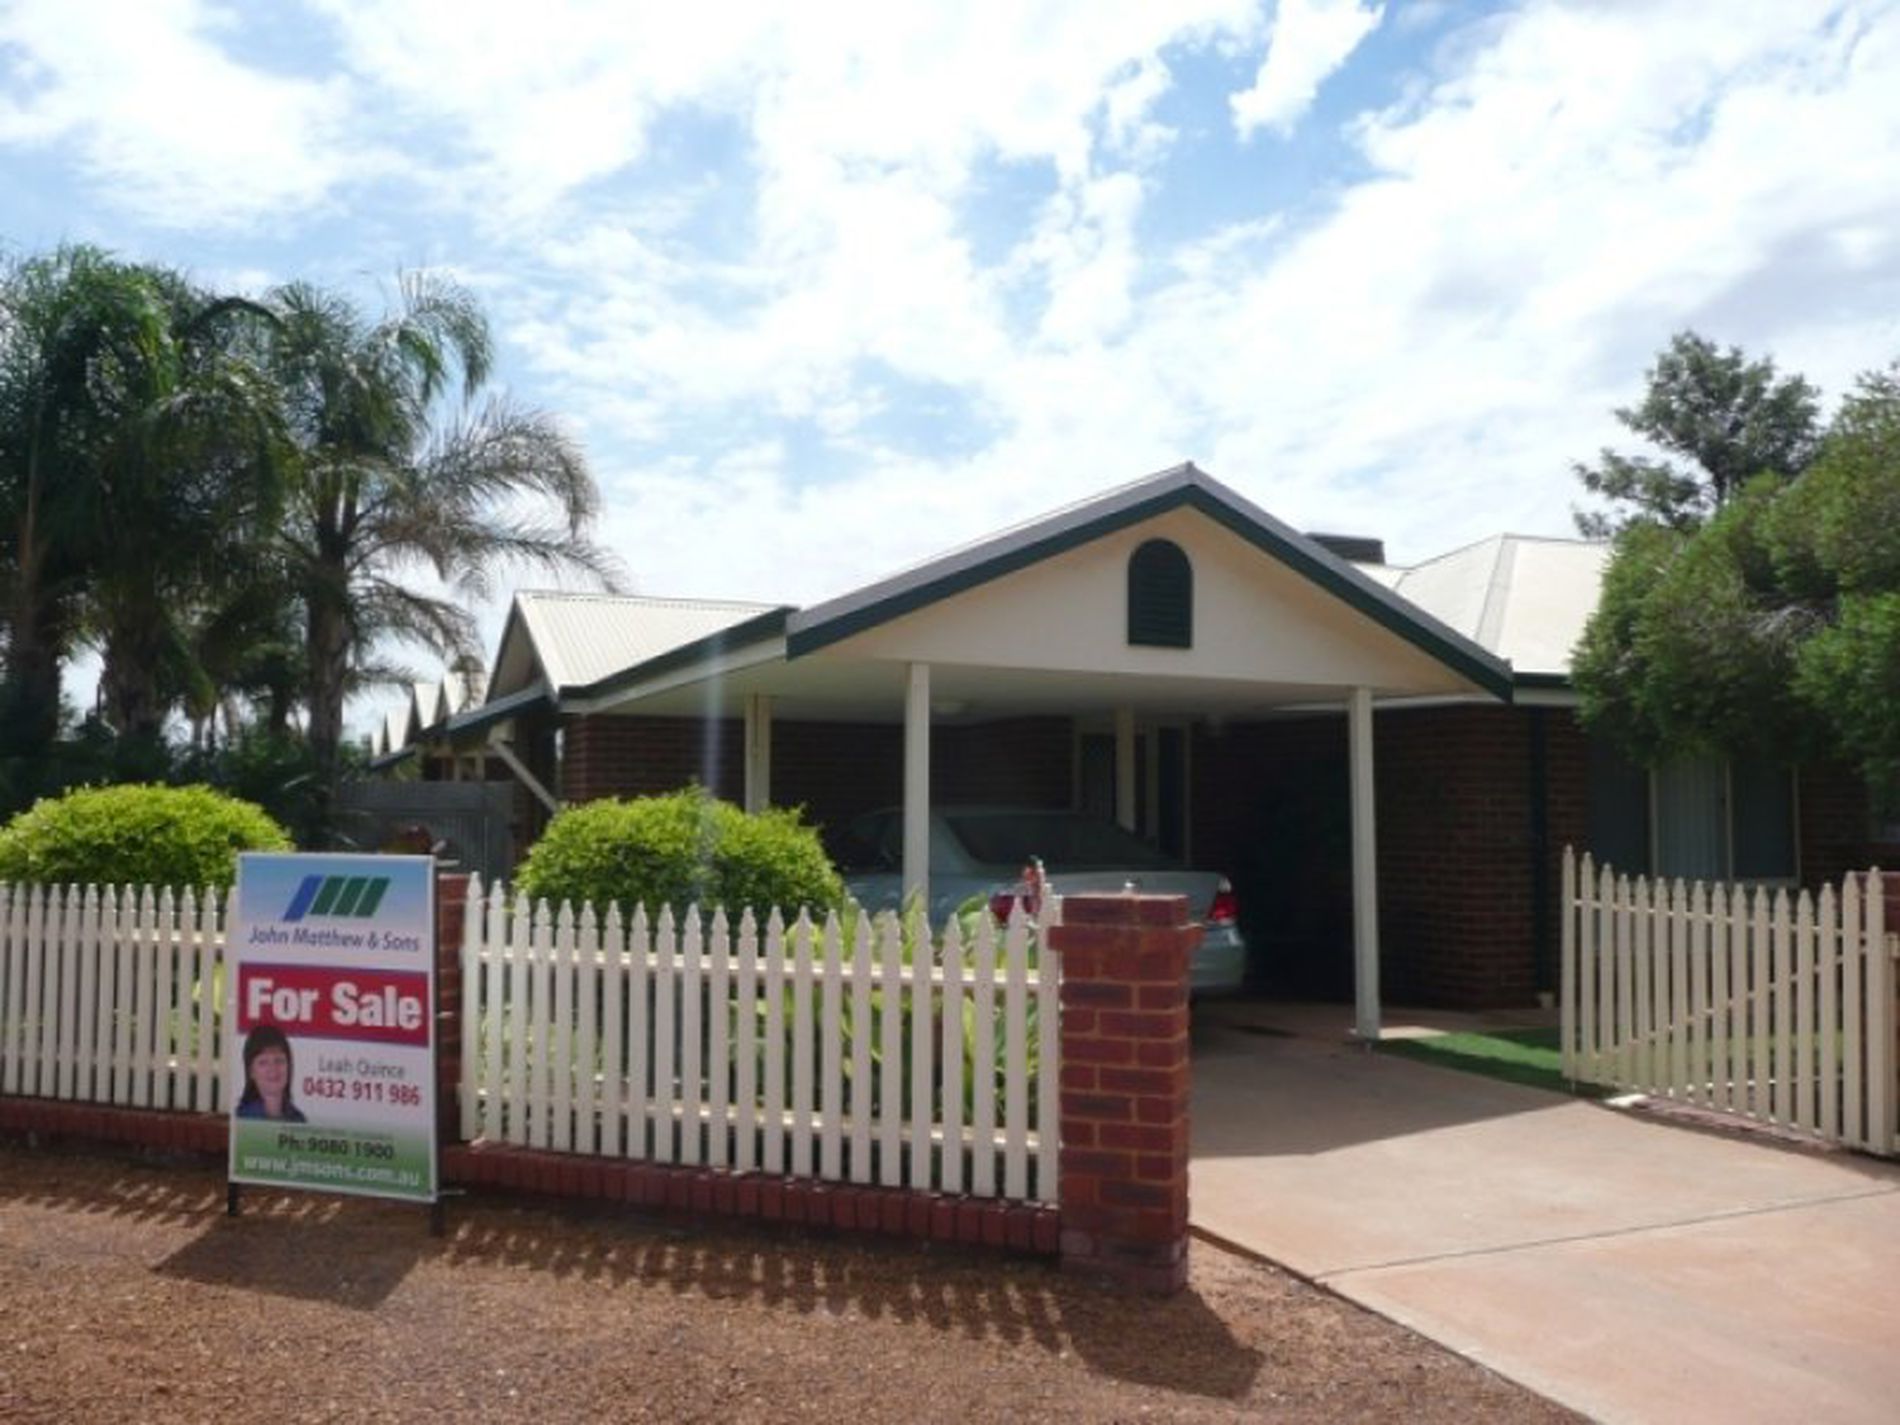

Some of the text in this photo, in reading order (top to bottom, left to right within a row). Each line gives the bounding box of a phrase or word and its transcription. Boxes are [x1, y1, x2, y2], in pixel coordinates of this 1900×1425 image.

[250, 925, 420, 951] John Matthew & Sons
[247, 977, 422, 1031] For Sale
[318, 1057, 350, 1074] Leah
[303, 1077, 346, 1099] 0432
[352, 1081, 383, 1102] 911
